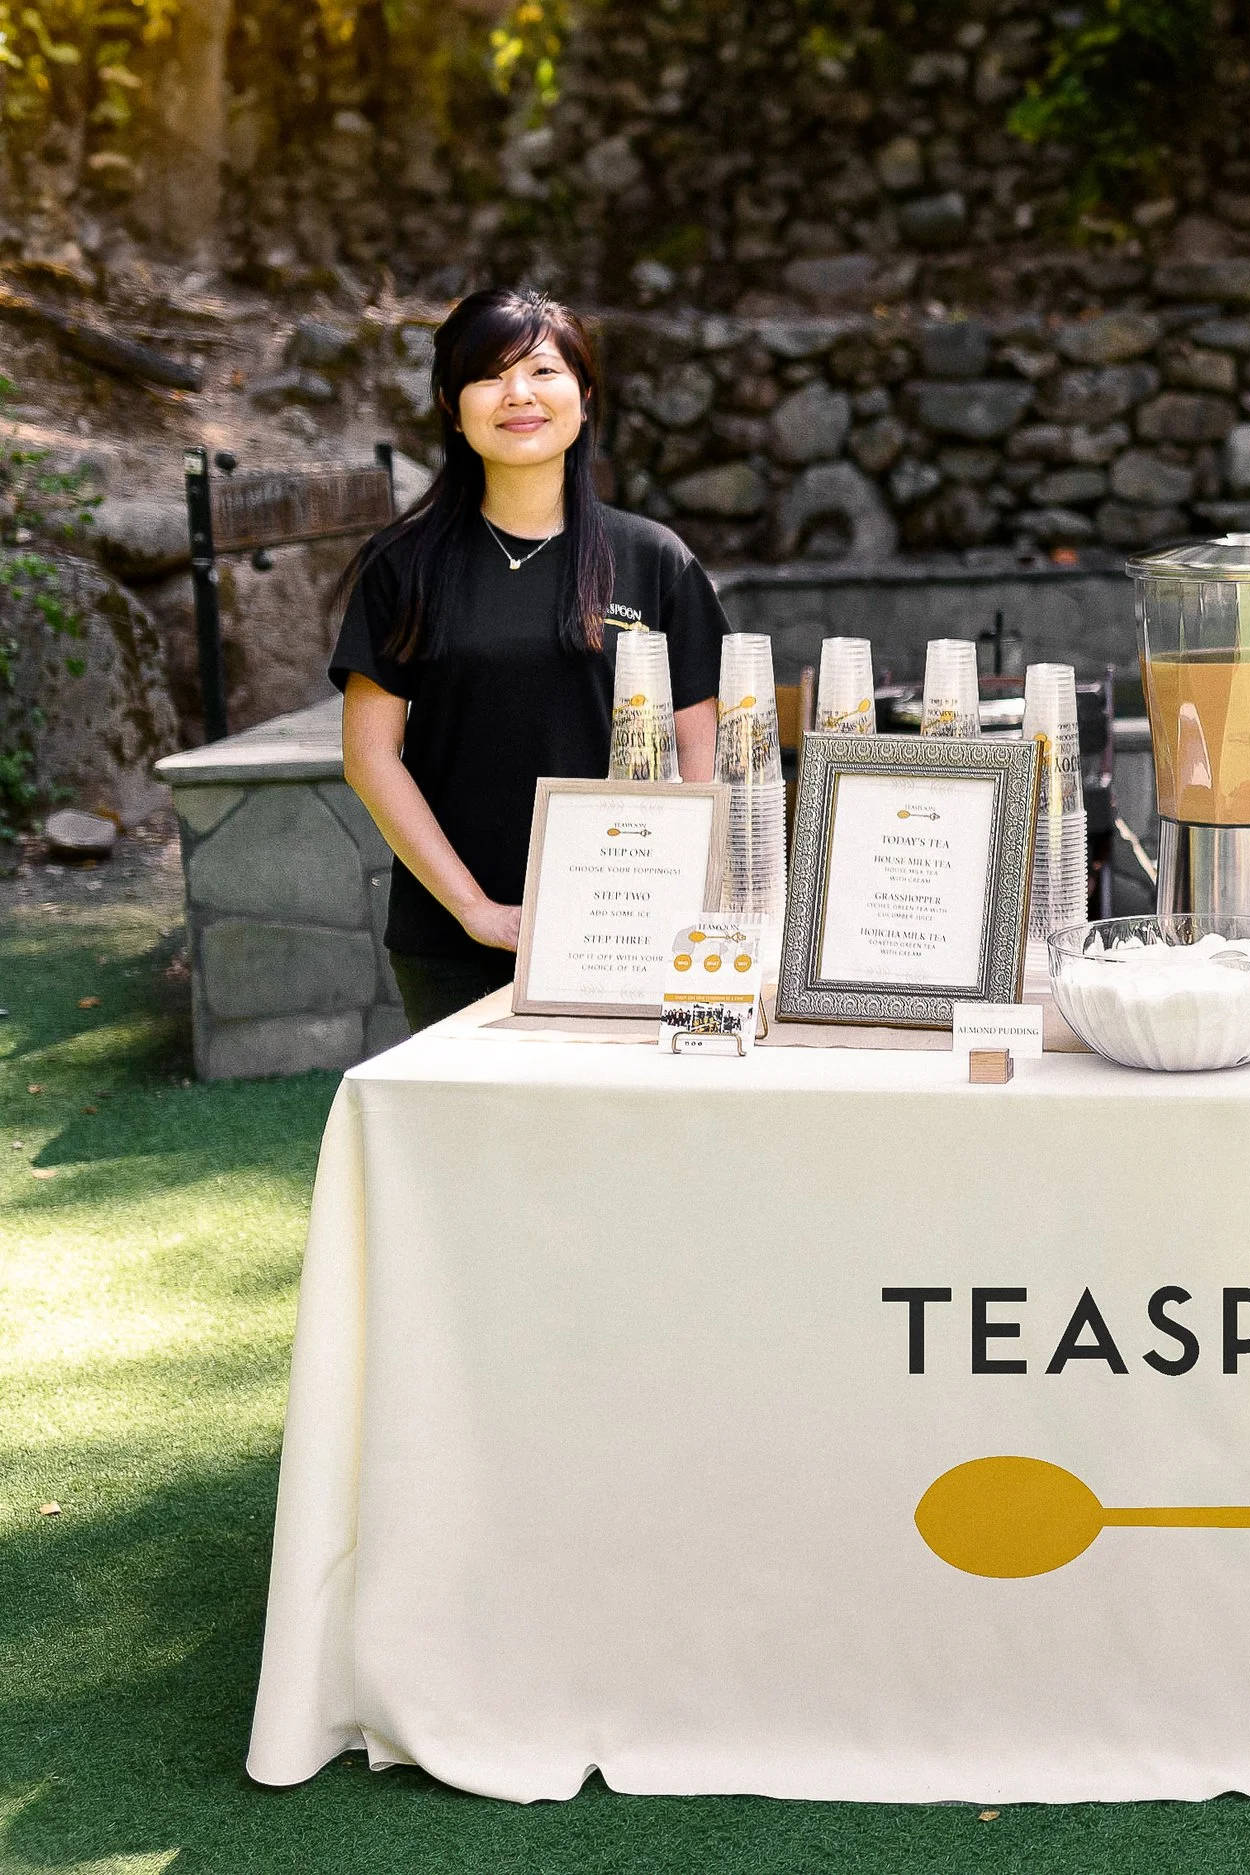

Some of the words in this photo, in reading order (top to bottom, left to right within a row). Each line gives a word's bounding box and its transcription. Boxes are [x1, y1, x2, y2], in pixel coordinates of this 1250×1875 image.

[882, 834, 926, 846] TODAY'S
[928, 838, 949, 849] TEA
[600, 847, 628, 857] STEP
[629, 848, 654, 858] ONE
[874, 854, 905, 865] HOUSE
[908, 857, 931, 867] MILK
[934, 859, 952, 869] TEA
[569, 864, 604, 873] CHOOSE
[608, 865, 631, 874] YOUR
[593, 891, 621, 901] STEP
[624, 891, 652, 901] TWO
[874, 892, 941, 905] GRASSHOPPER
[590, 909, 608, 917] ADD
[584, 935, 612, 944] STEP
[614, 935, 651, 945] THREE
[902, 931, 926, 941] MILK
[928, 933, 946, 942] TEA
[568, 952, 585, 960] TOP
[640, 954, 663, 962] YOUR
[581, 964, 613, 972] CHOICE
[617, 964, 628, 972] OF
[632, 964, 647, 972] TEA
[958, 1025, 997, 1035] ALMOND
[998, 1026, 1039, 1036] PUDDING
